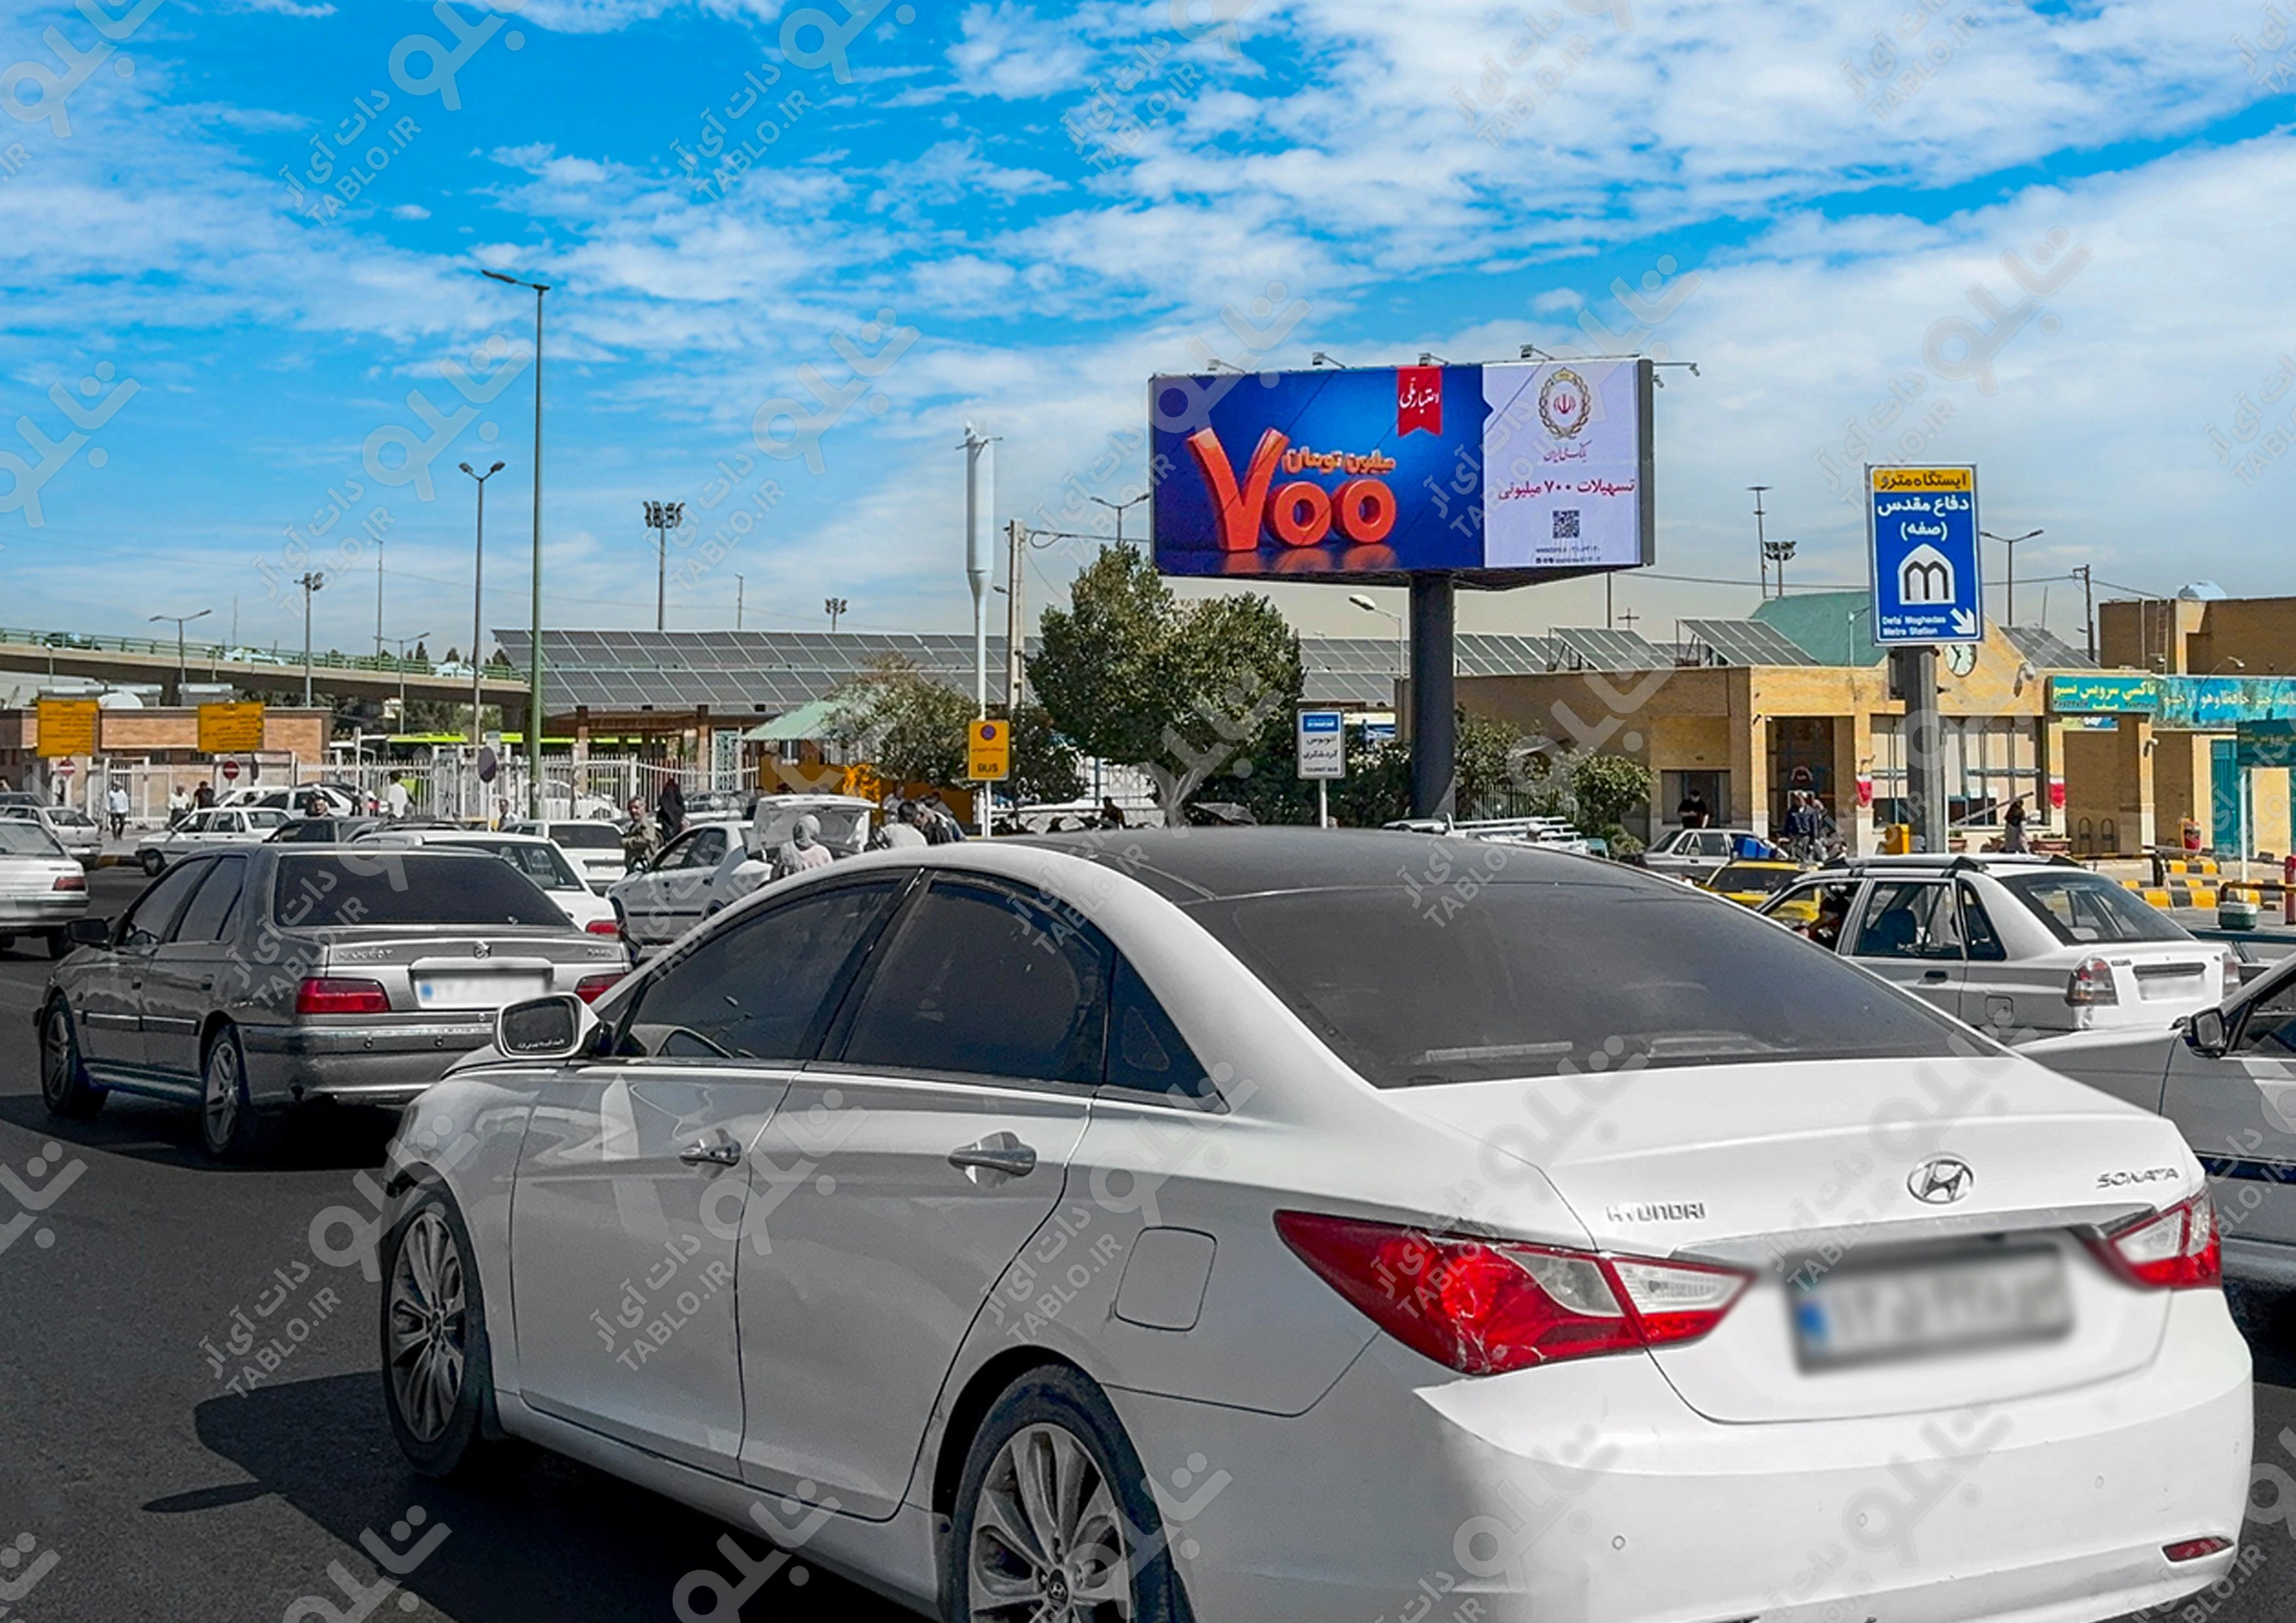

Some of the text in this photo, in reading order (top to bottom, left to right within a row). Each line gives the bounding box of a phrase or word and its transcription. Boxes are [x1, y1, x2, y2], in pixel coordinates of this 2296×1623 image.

[1282, 446, 1397, 474] میلیون تومان
[1498, 478, 1635, 500] تسهیلات ۷۰۰ میلیونی
[1880, 473, 1966, 490] ایستگاه مترو
[1877, 495, 1969, 517] دفاع مقدس
[977, 762, 999, 773] BUS
[2096, 1168, 2179, 1190] SONATA
